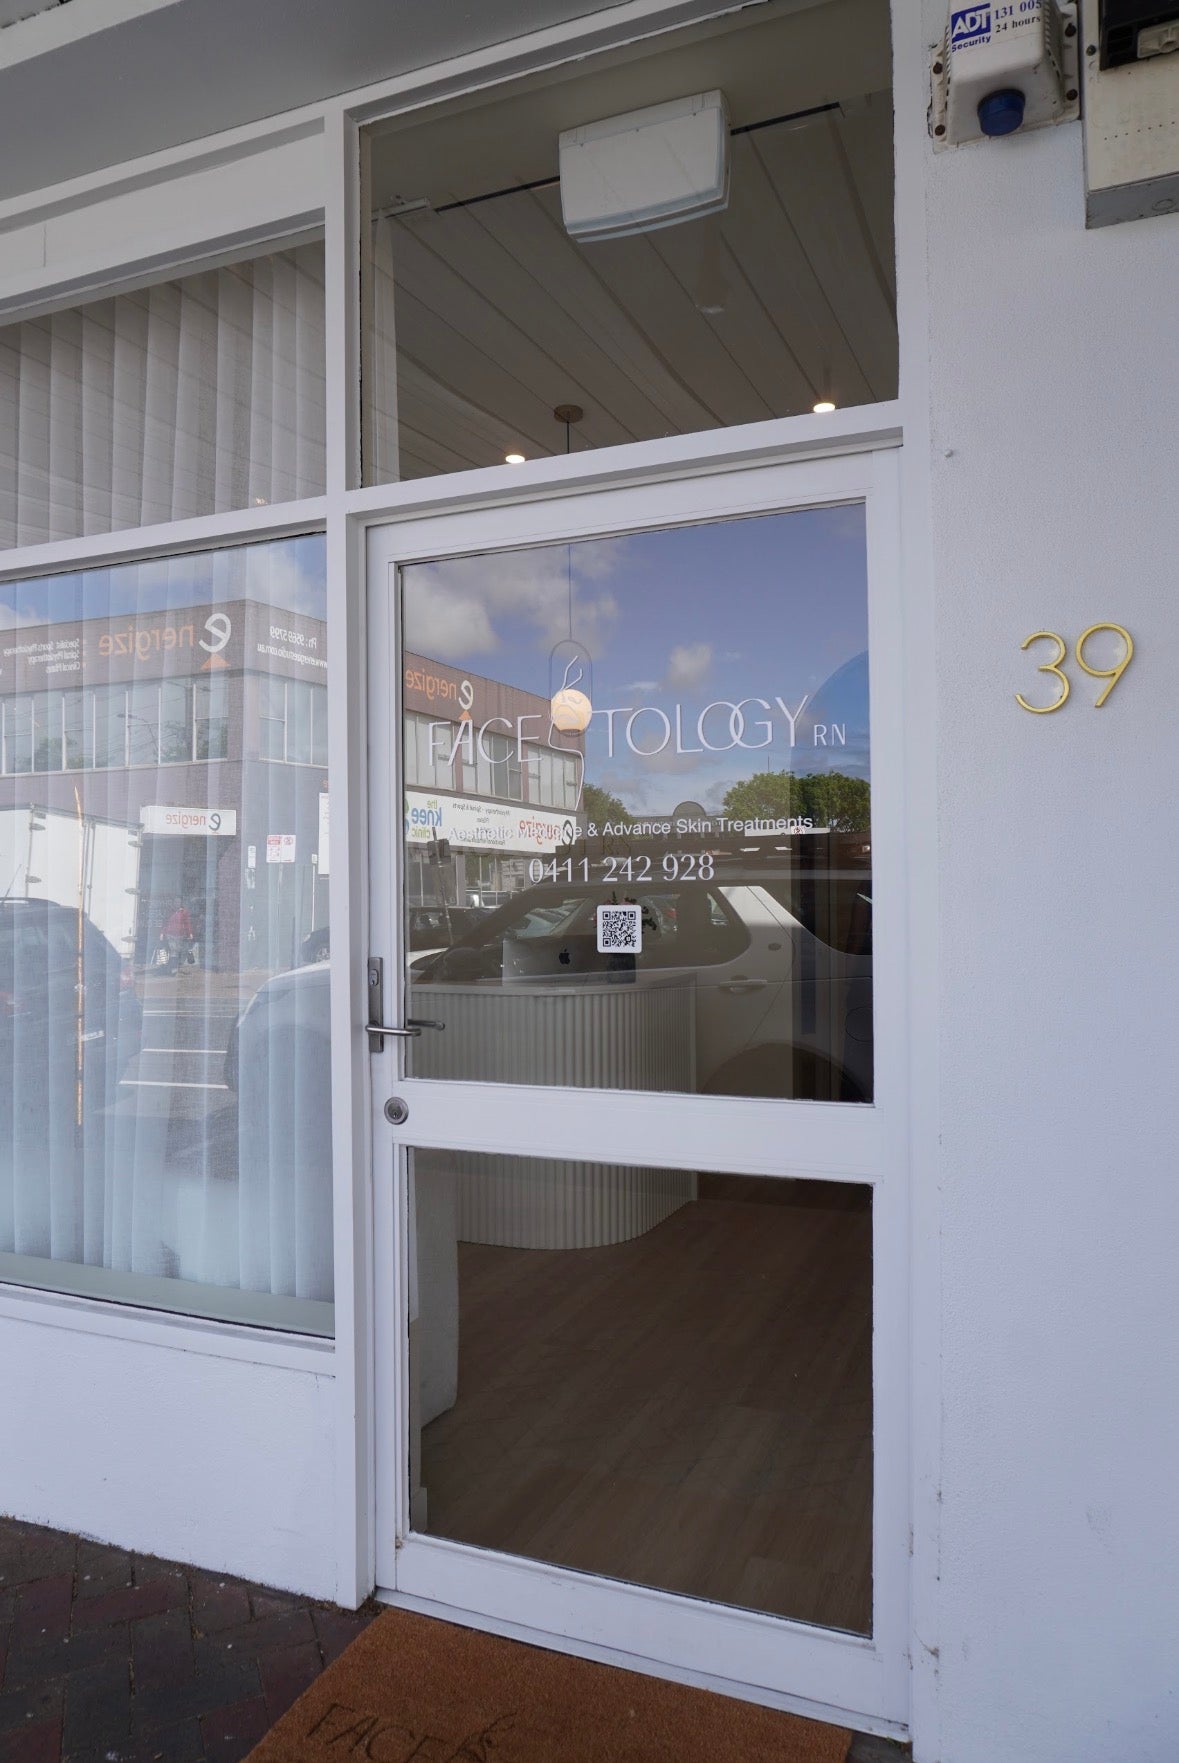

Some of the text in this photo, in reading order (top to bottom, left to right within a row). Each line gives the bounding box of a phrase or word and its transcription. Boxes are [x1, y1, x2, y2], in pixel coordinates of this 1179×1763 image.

[994, 0, 1042, 20] 131 005
[952, 9, 991, 38] ADT
[995, 14, 1041, 33] 24 hours
[951, 35, 991, 53] Security
[1014, 622, 1135, 714] 39
[813, 723, 847, 746] RN
[587, 822, 599, 836] &
[602, 820, 672, 836] Advance
[676, 818, 713, 834] Skin
[717, 815, 813, 833] Treatments
[528, 853, 715, 884] 0411 242 928
